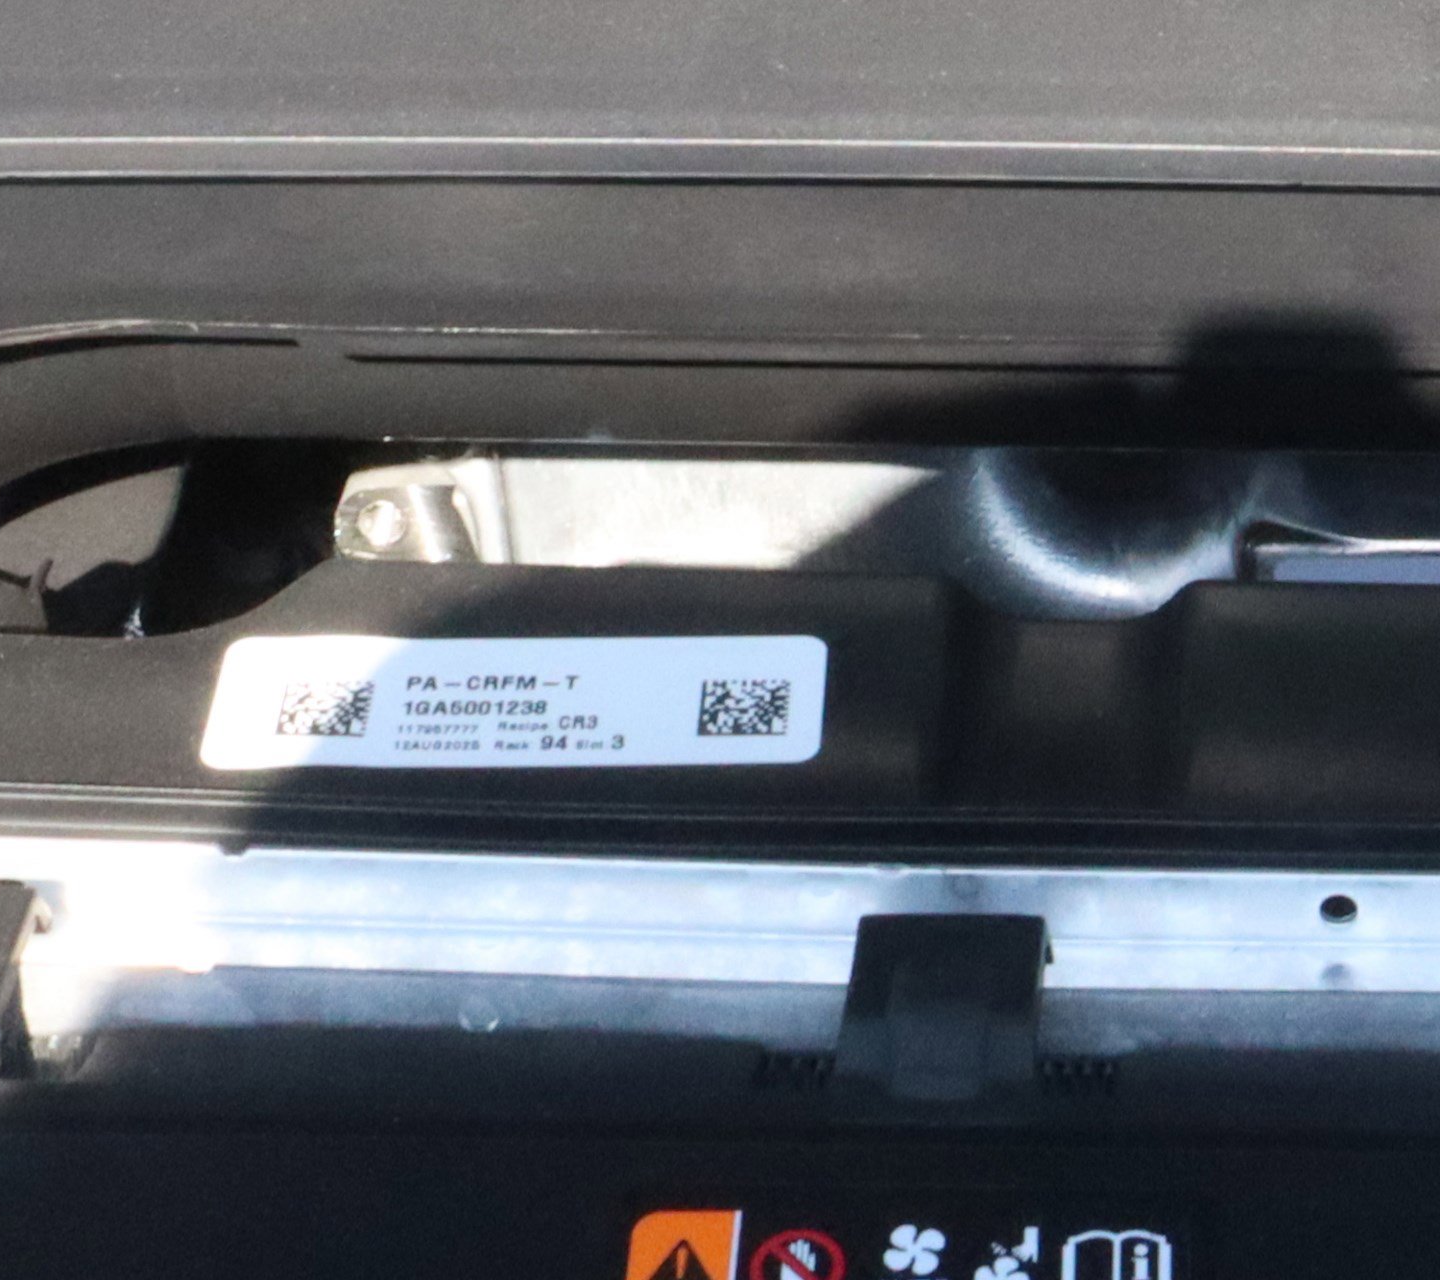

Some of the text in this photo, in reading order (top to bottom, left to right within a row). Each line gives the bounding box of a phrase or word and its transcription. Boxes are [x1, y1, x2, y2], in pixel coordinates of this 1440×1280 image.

[558, 715, 599, 730] CR3
[540, 734, 569, 750] 94
[611, 734, 626, 750] 3
